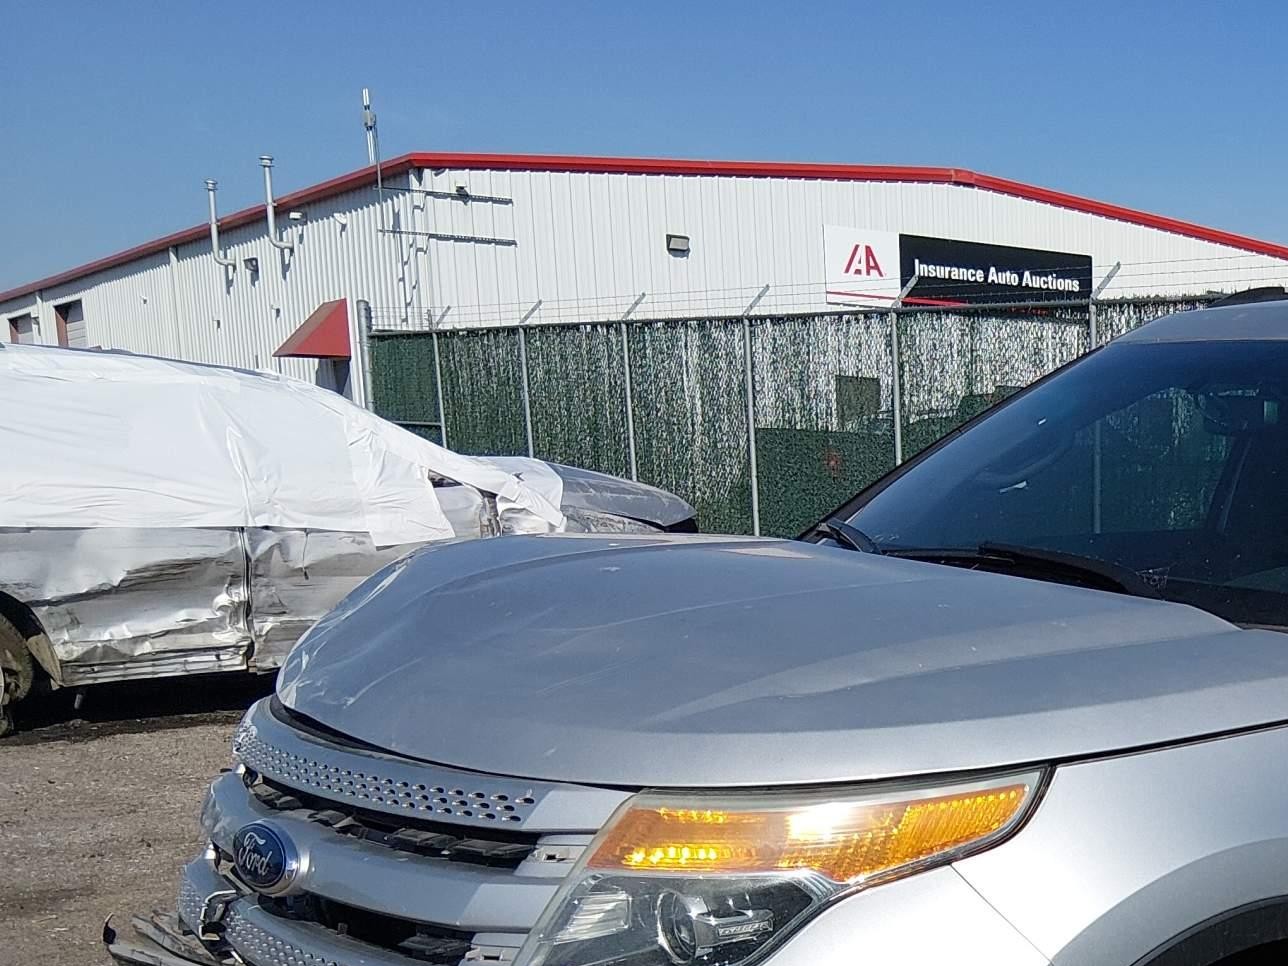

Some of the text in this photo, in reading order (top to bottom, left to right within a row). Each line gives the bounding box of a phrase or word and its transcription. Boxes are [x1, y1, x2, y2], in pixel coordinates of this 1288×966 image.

[914, 258, 1080, 292] Insurance Auto Auctions
[239, 831, 273, 876] Ford
